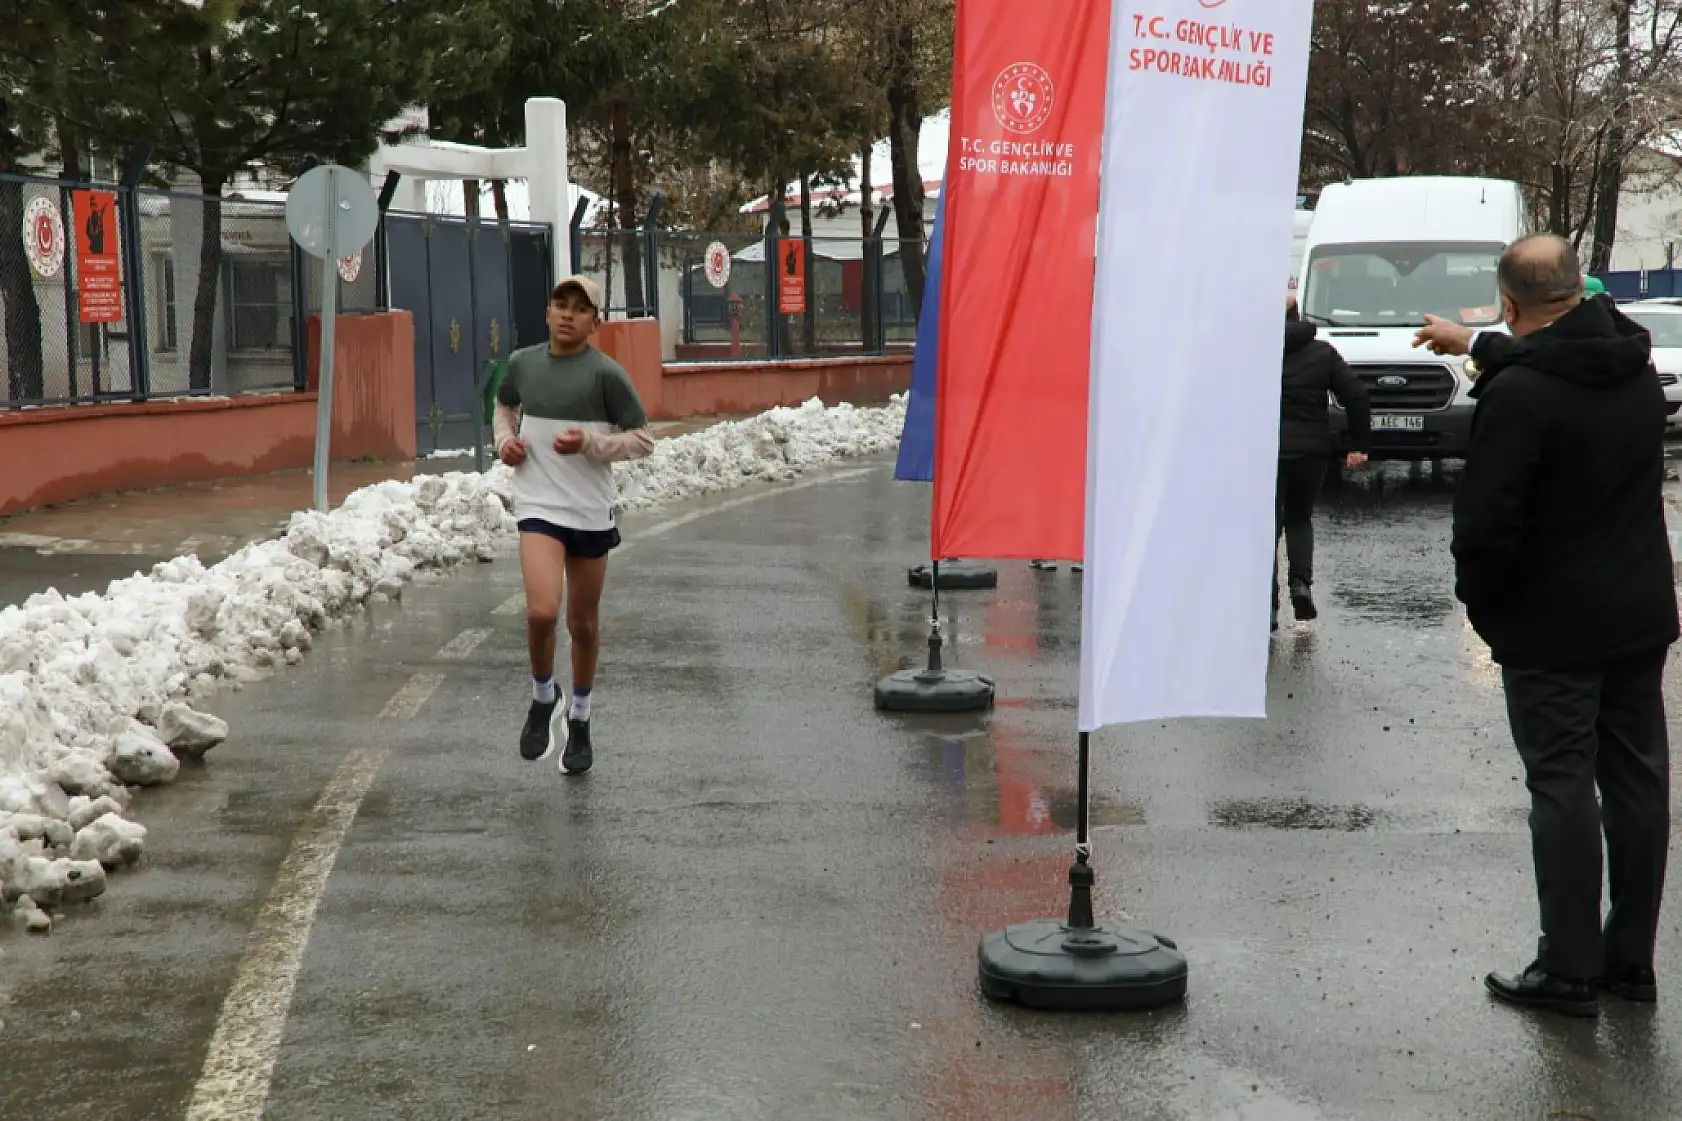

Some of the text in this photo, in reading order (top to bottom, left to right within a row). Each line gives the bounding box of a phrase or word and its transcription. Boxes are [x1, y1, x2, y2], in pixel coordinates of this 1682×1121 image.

[1132, 13, 1170, 39] T.C.
[1249, 31, 1274, 55] VE
[1128, 48, 1271, 88] SPOR BAKANLIĞI
[961, 137, 1074, 160] T.C. GENÇLİK VE
[959, 156, 1072, 176] SPOR BAKANLIĞI
